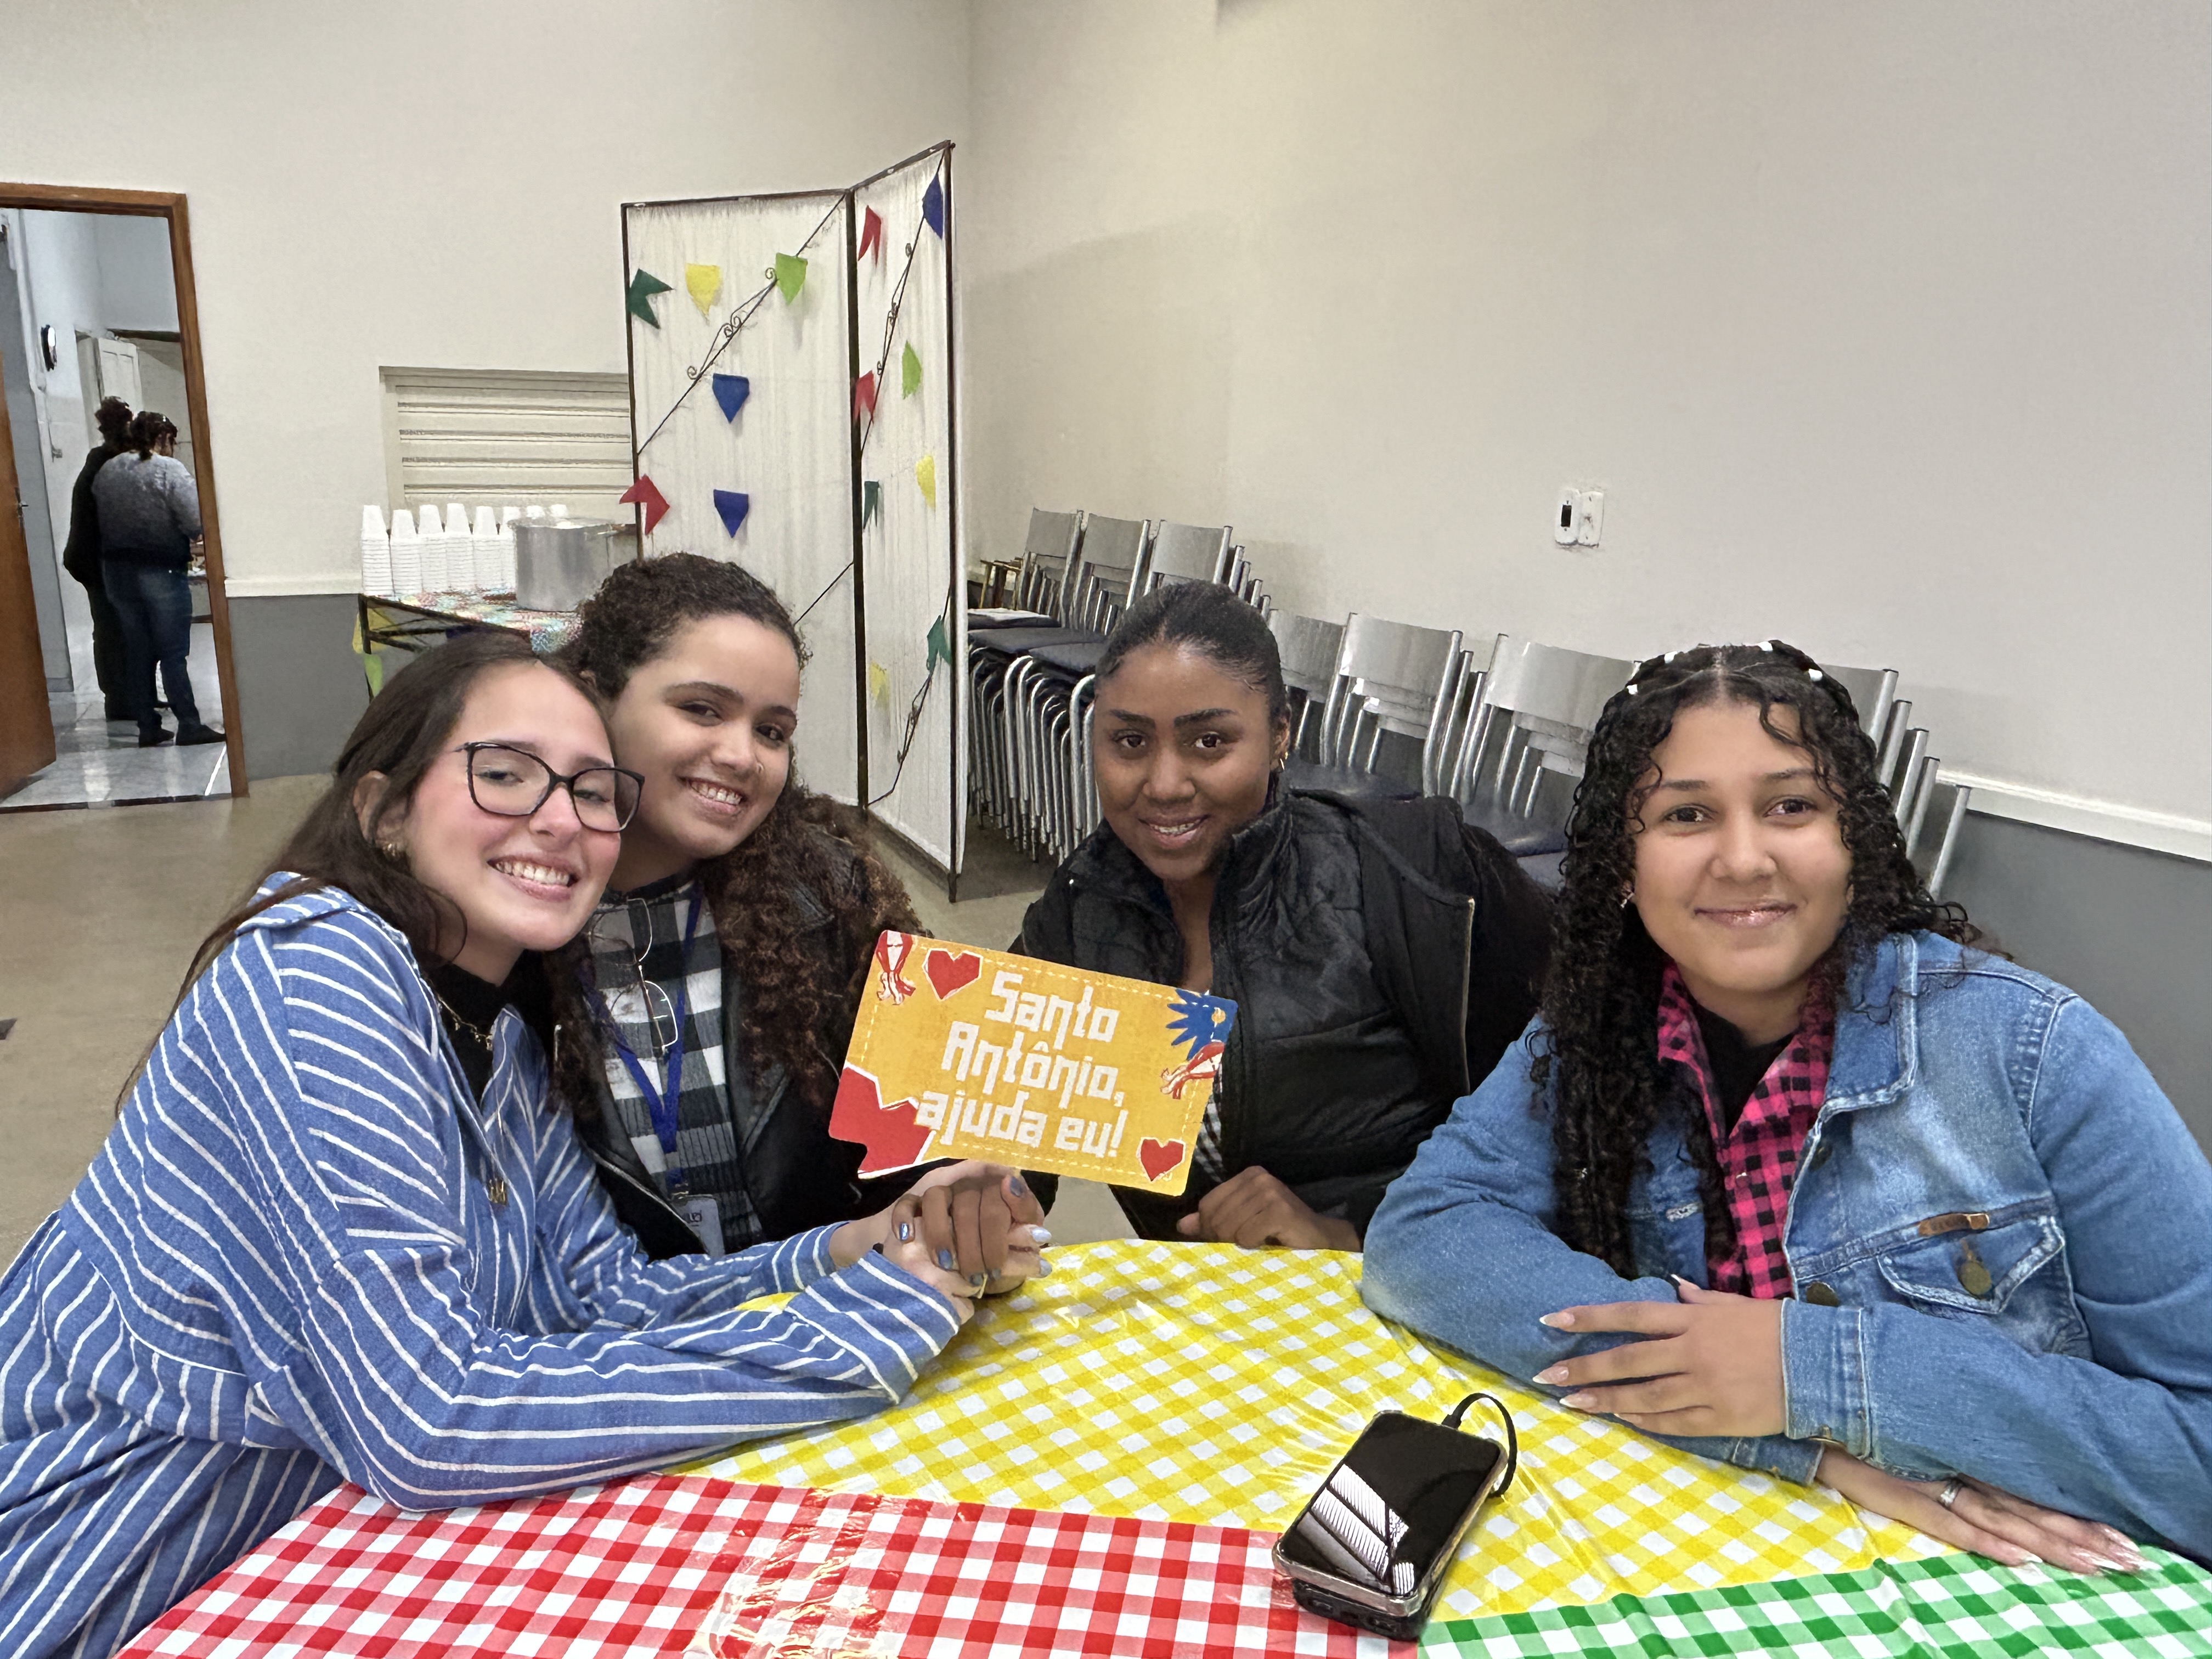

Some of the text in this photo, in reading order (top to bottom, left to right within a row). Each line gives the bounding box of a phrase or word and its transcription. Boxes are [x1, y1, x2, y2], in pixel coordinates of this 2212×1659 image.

[984, 970, 1119, 1050] Santo
[941, 1020, 1124, 1109] Antônio,
[914, 1091, 1128, 1158] ajuda eu!
